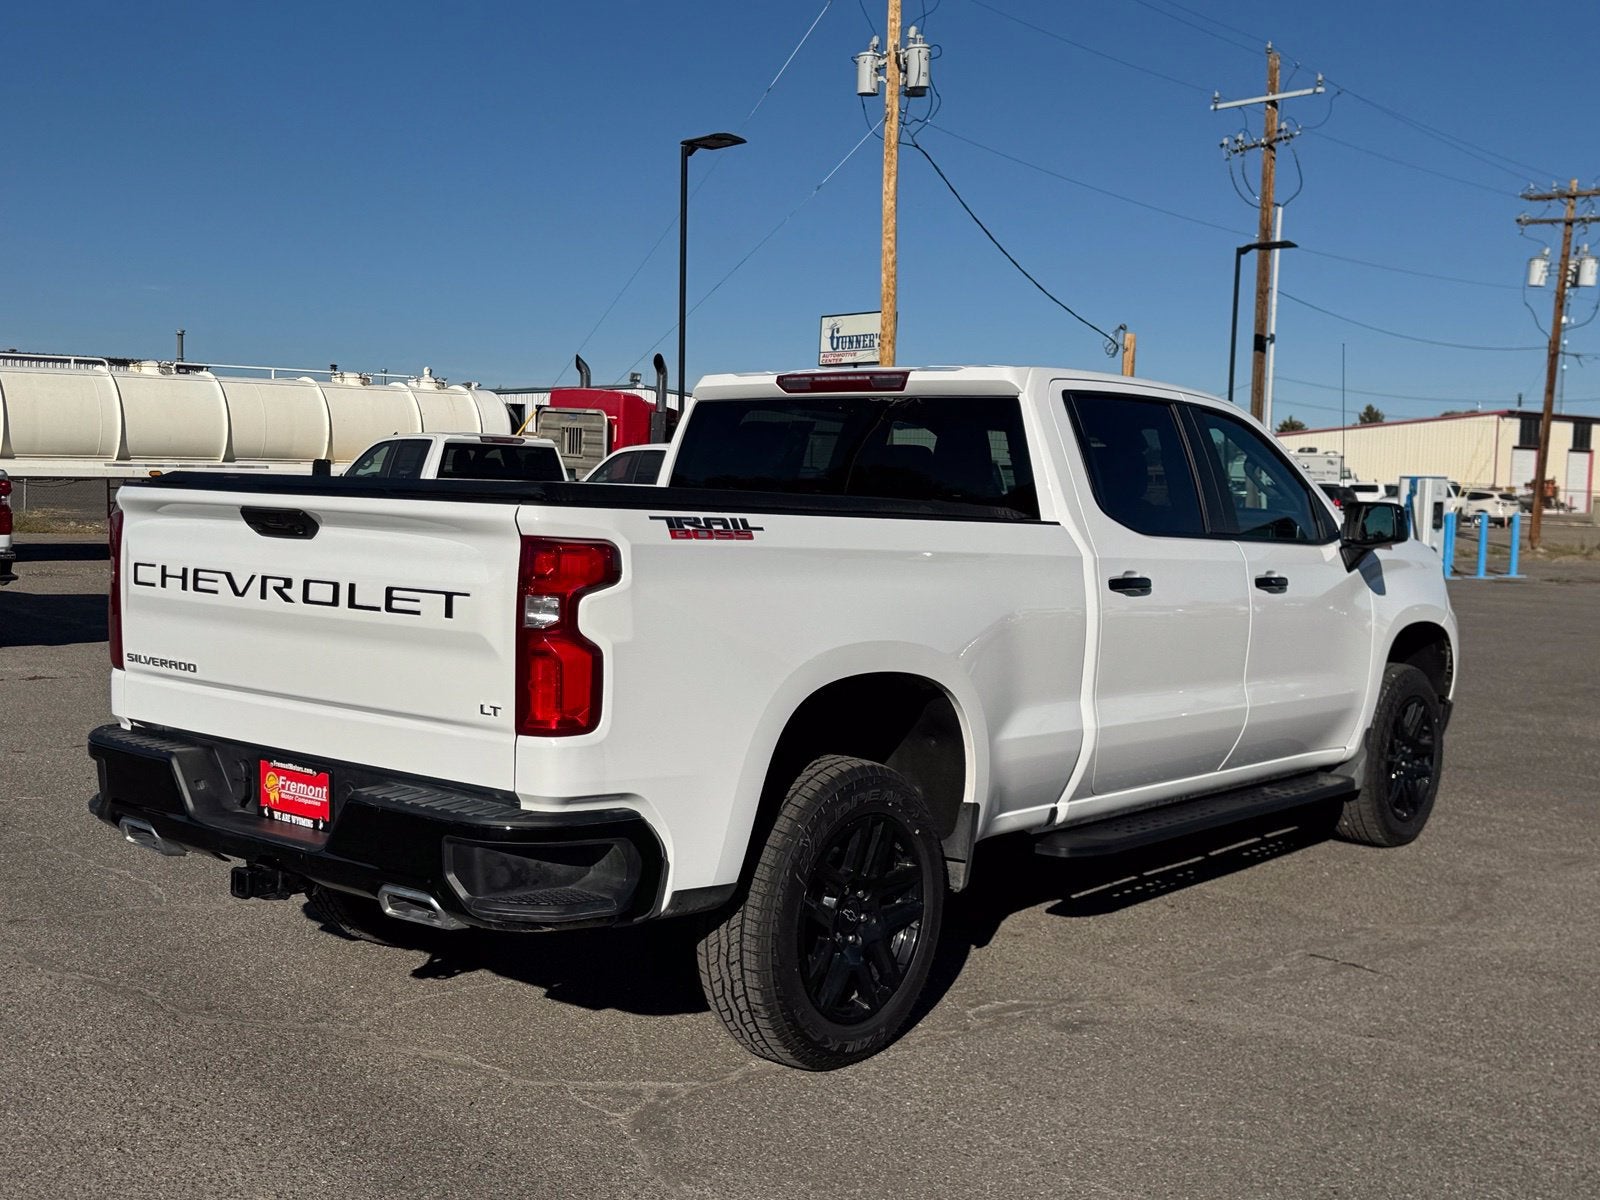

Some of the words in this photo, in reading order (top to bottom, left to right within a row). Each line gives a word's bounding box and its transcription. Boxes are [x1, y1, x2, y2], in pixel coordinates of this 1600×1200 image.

[829, 327, 881, 351] GUNNER'
[648, 516, 765, 531] TRAIL
[669, 529, 754, 540] BOSS
[133, 562, 471, 619] CHEVROLET
[126, 652, 197, 674] SILVERADO
[480, 704, 501, 717] LT
[279, 776, 327, 799] Fremont
[281, 792, 294, 800] Motor
[295, 795, 321, 806] Companies
[273, 811, 281, 820] WE
[282, 812, 291, 823] ARE
[291, 815, 314, 828] WYOMING
